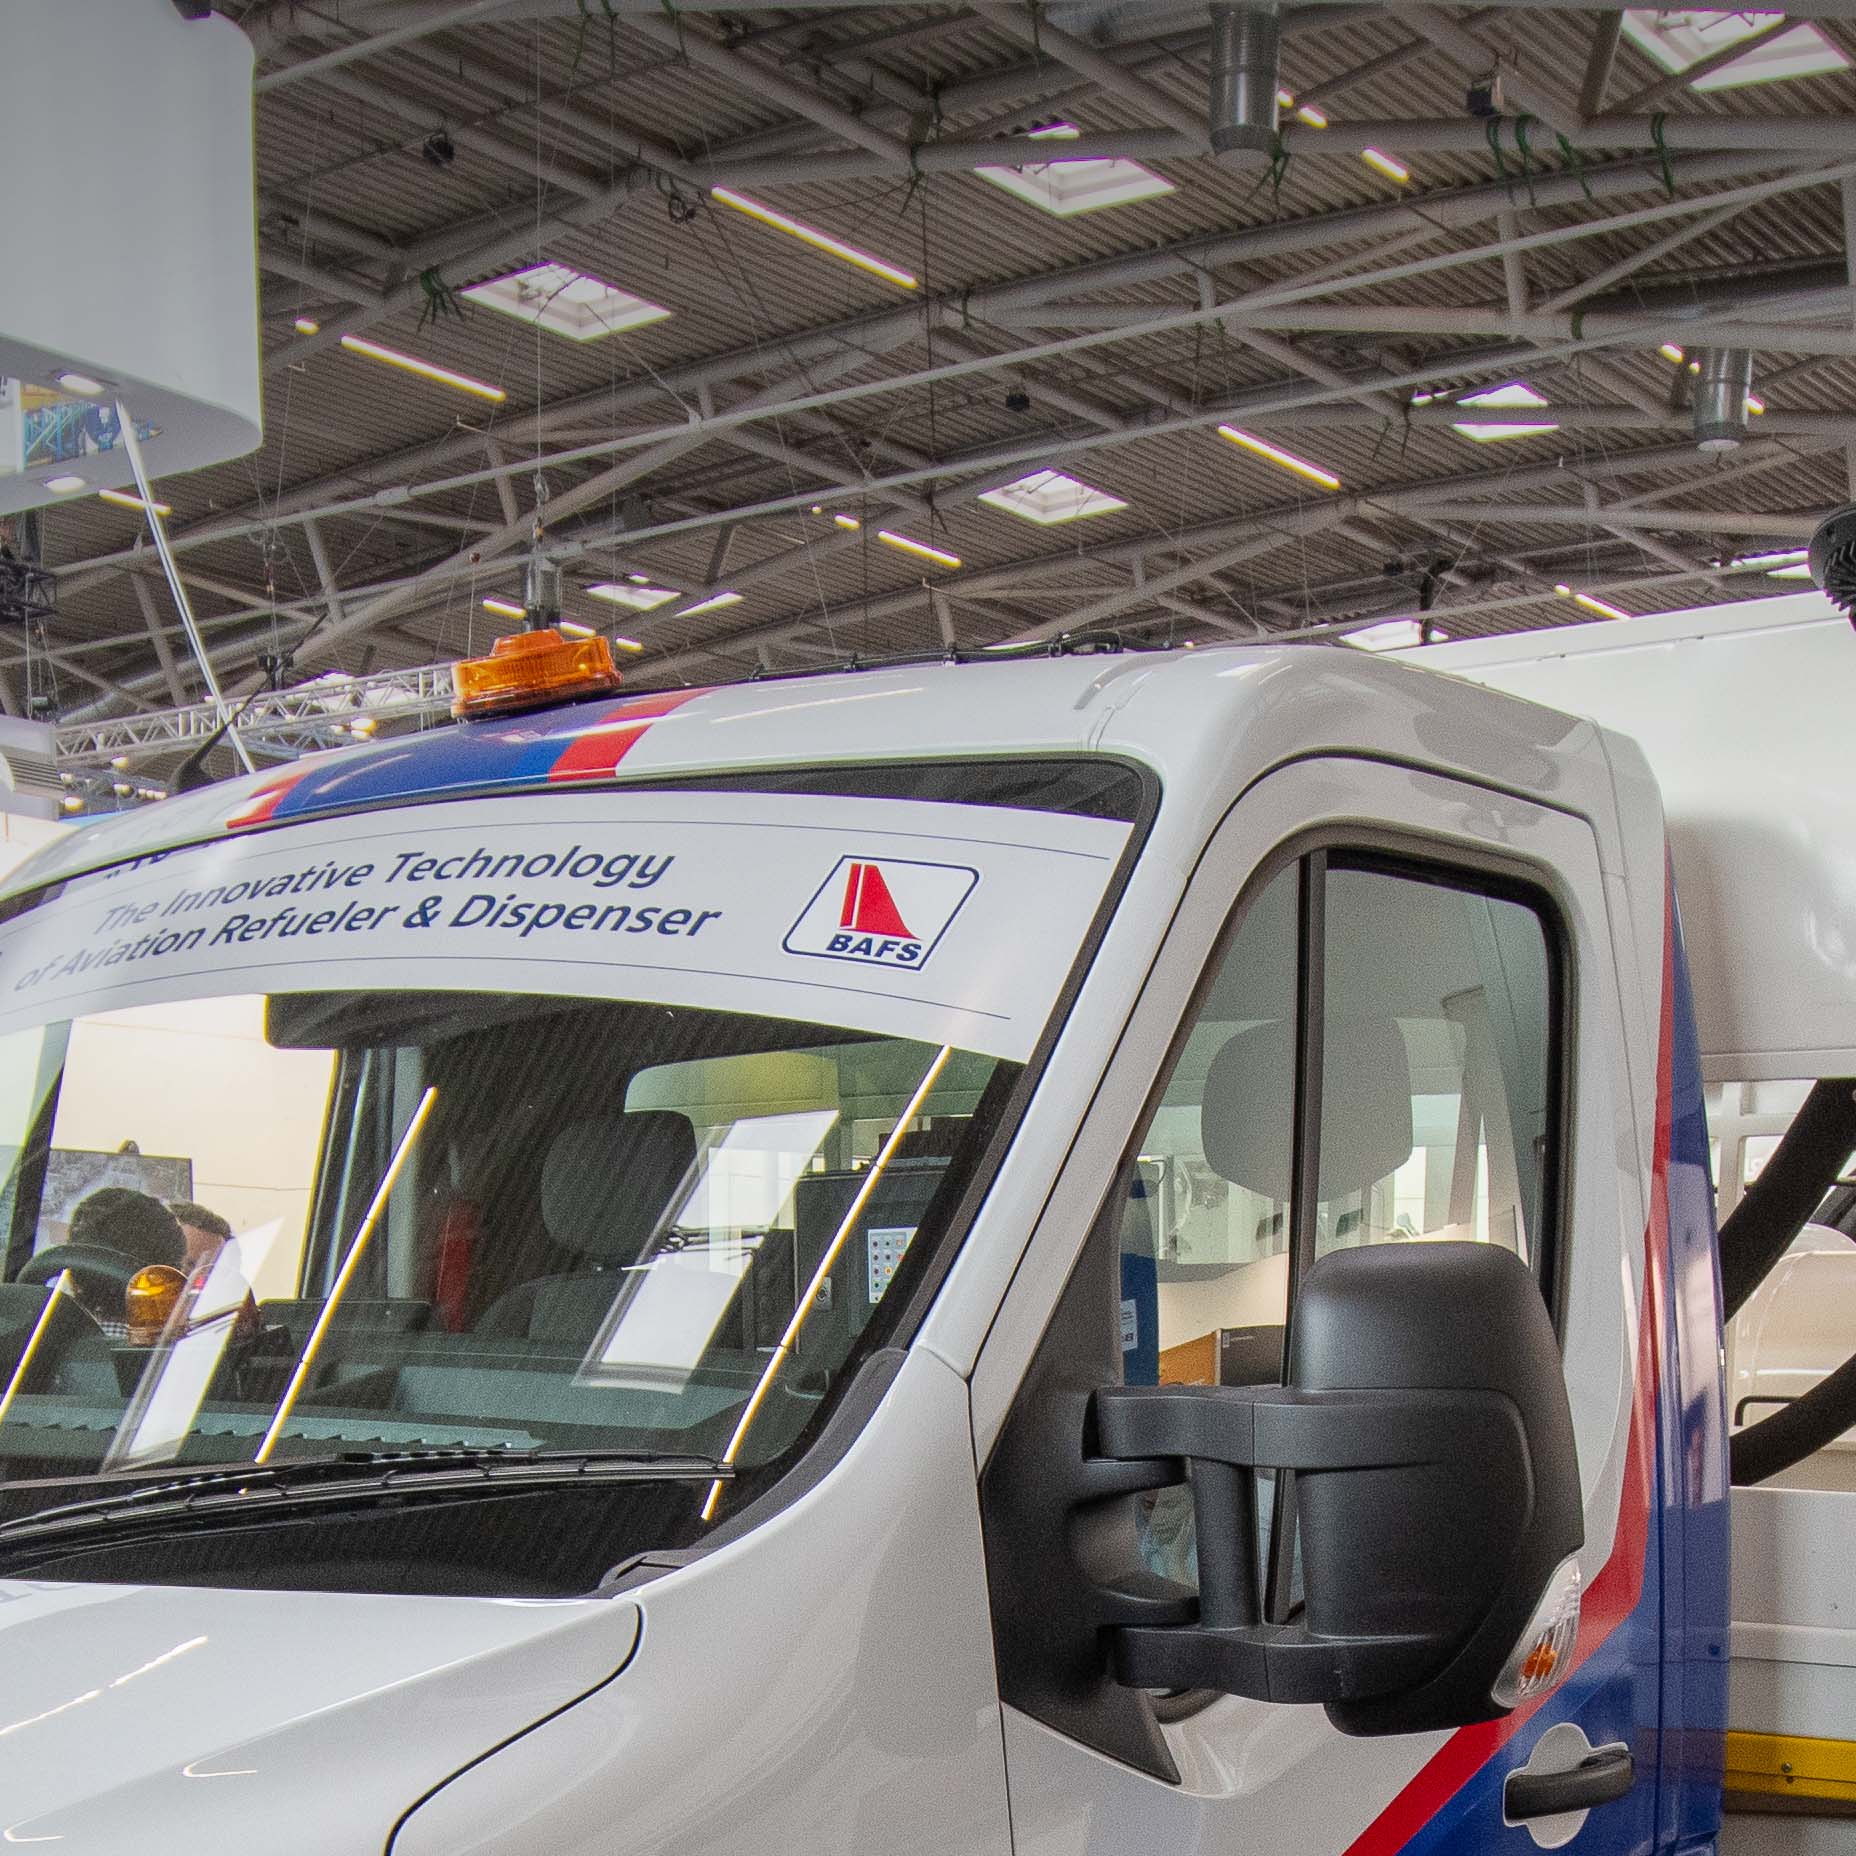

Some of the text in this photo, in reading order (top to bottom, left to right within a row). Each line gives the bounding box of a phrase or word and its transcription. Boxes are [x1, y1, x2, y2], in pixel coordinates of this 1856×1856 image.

[94, 901, 160, 934] The
[160, 860, 375, 917] Innovative
[384, 845, 675, 889] Technology
[13, 960, 62, 992] of
[54, 927, 207, 980] Aviation
[209, 900, 399, 948] Refueler
[401, 895, 443, 928] &
[449, 895, 722, 938] Dispenser
[825, 933, 924, 963] BAFS
